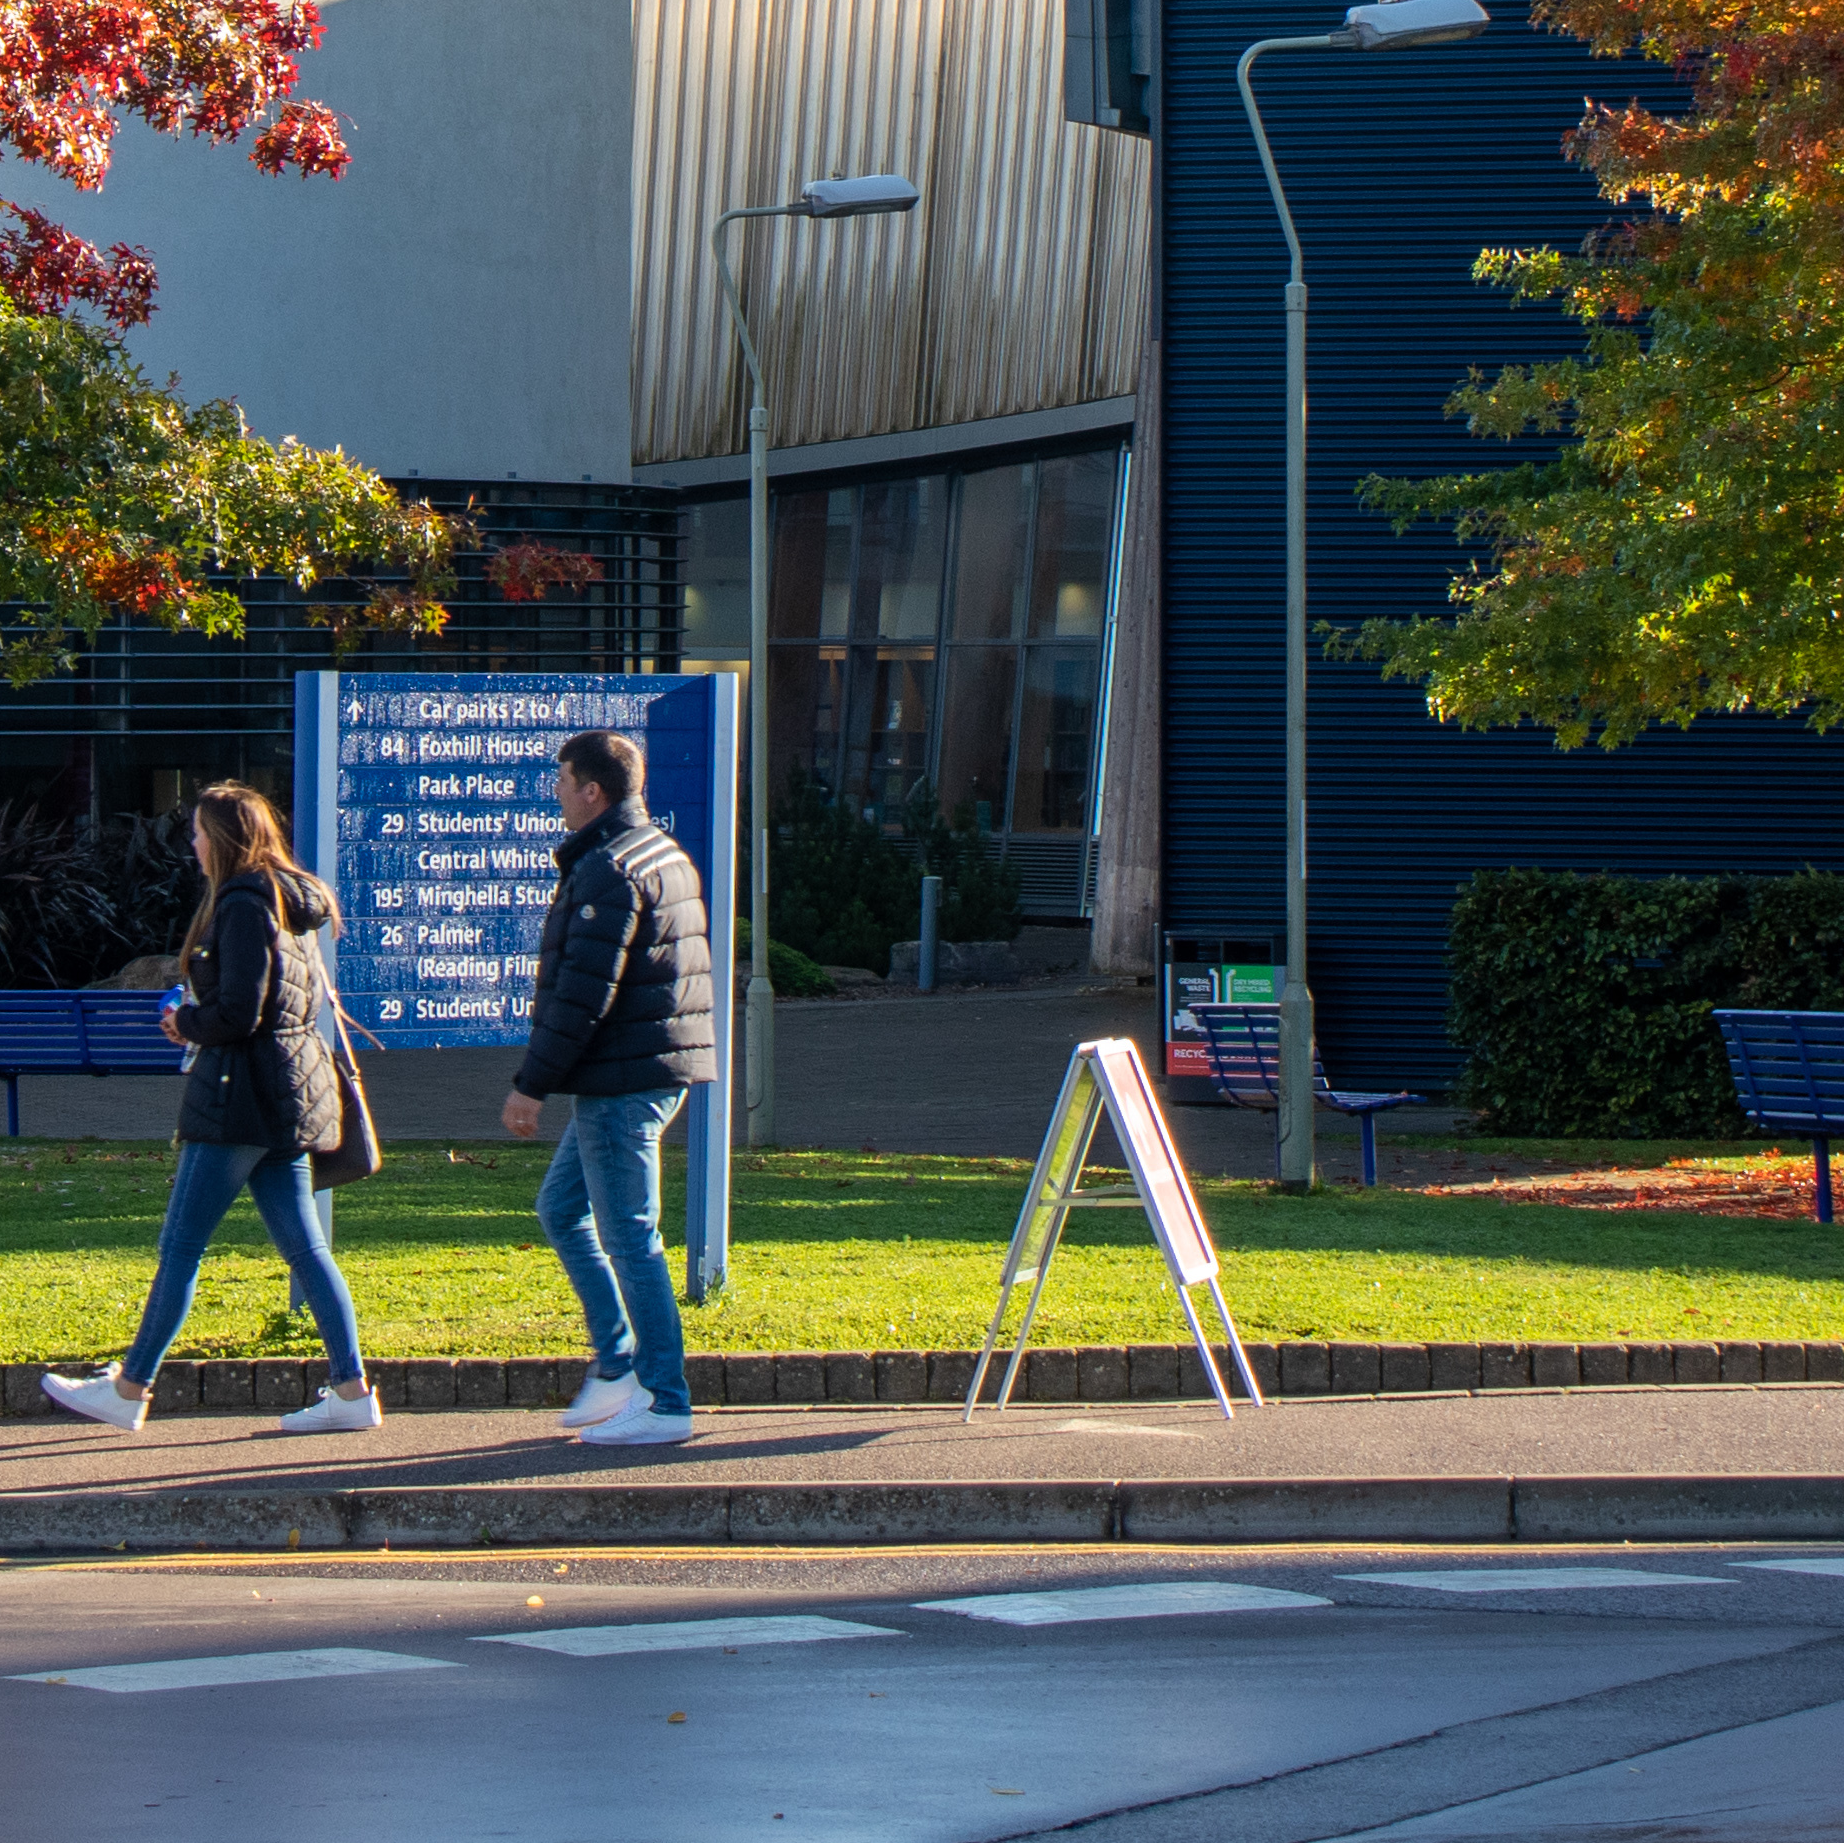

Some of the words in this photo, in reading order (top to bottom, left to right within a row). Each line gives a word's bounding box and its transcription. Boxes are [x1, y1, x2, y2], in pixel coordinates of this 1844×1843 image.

[419, 699, 451, 719] Car
[457, 699, 508, 725] parks
[513, 700, 524, 719] 2
[531, 702, 550, 719] to
[554, 700, 567, 719] 4
[380, 737, 404, 756] 84
[419, 735, 481, 756] Foxhill
[487, 736, 545, 756] House
[419, 774, 460, 795] Park
[466, 773, 515, 795] Place
[381, 814, 404, 833] 29
[418, 811, 508, 833] Students'
[514, 811, 568, 833] Union
[418, 848, 486, 870] Central
[373, 888, 403, 907] 195
[418, 885, 510, 912] Minghella
[381, 925, 403, 945] 26
[418, 924, 483, 945] Palmer
[418, 956, 499, 982] (Reading
[380, 999, 403, 1019] 29
[416, 996, 506, 1019] Students'
